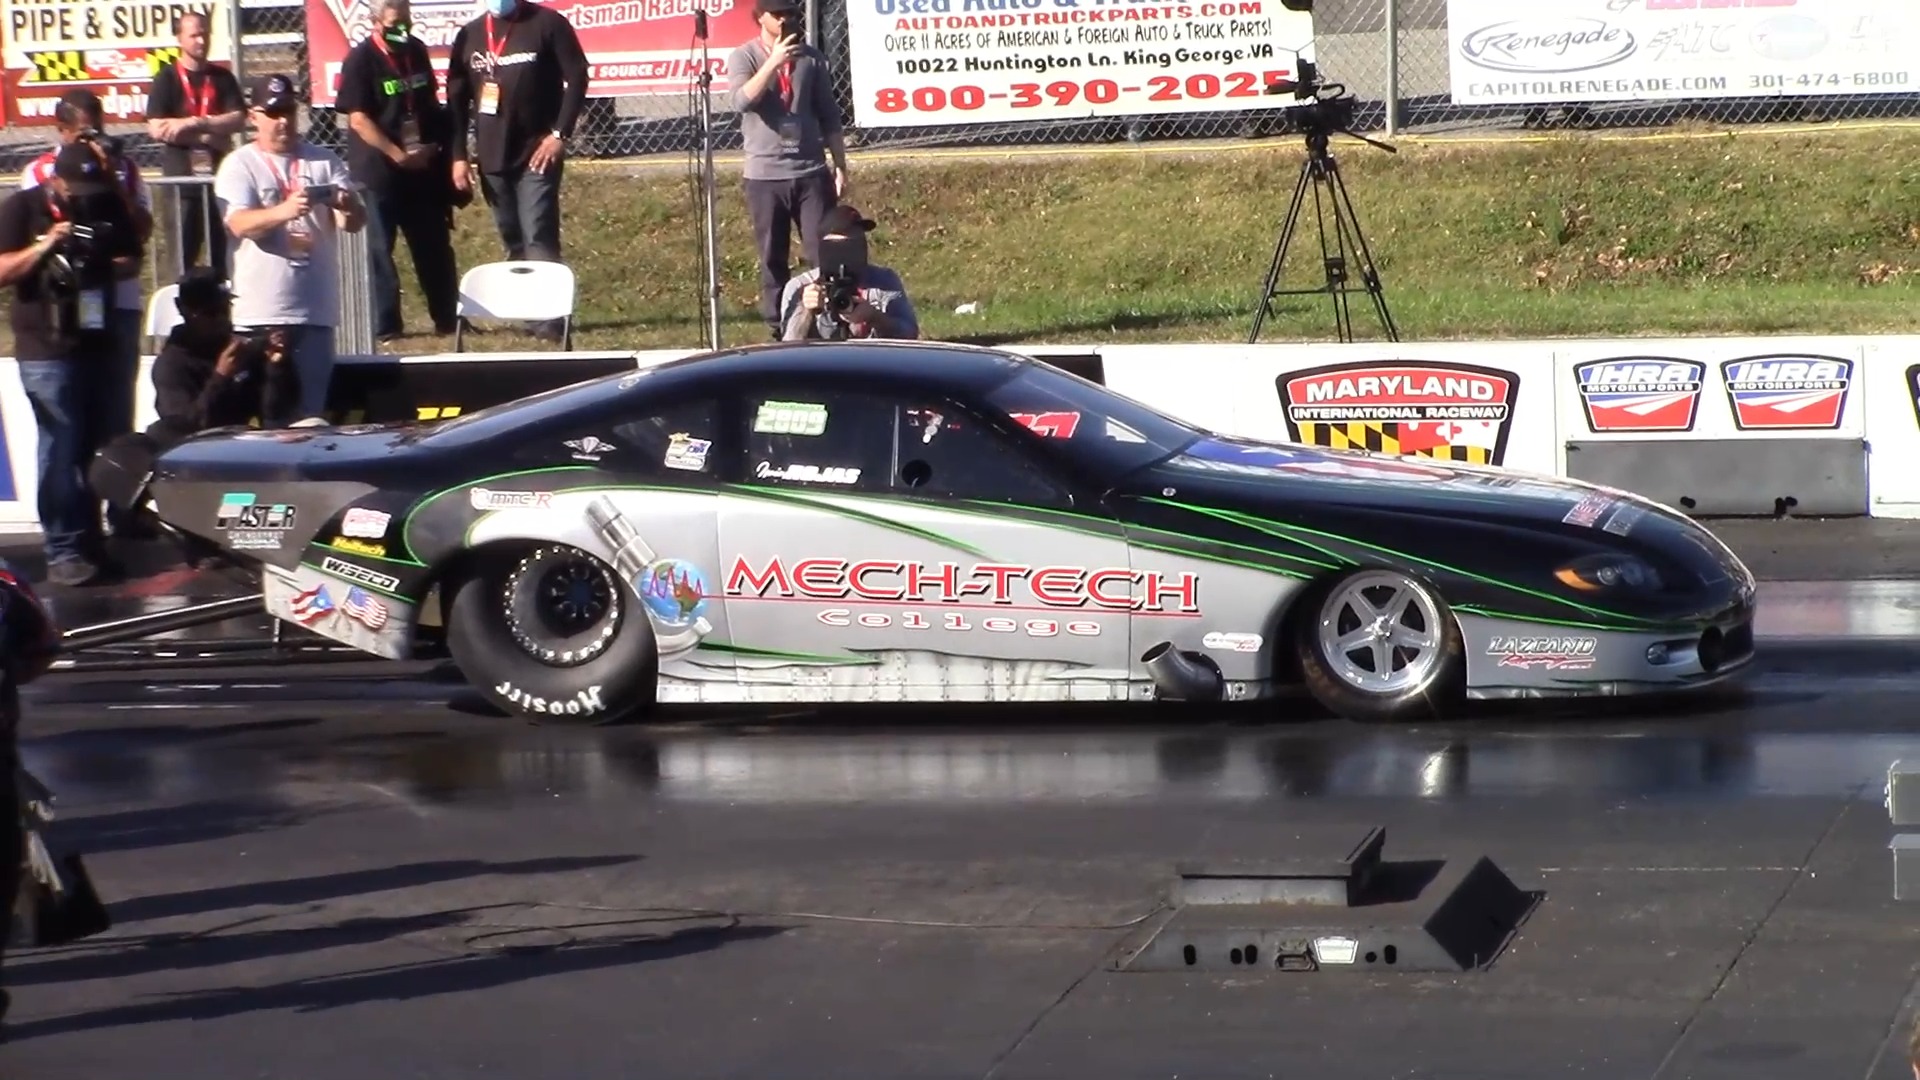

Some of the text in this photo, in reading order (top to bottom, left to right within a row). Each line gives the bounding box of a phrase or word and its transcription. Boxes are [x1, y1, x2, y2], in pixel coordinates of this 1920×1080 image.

[11, 8, 73, 41] PIPE
[85, 7, 101, 39] &
[895, 2, 1261, 31] AUTOANDTRUCKPARTS.COM
[1064, 28, 1072, 45] &
[1173, 23, 1181, 40] &
[1477, 22, 1620, 60] Renegade
[599, 63, 654, 77] SOURCE
[654, 62, 668, 76] of
[896, 58, 958, 74] 10022
[965, 53, 1081, 73] Huntington
[1088, 52, 1117, 67] Ln.
[1124, 49, 1171, 67] King
[1469, 71, 1909, 97] CAPITOLRENEGADE.COM 301-474-6800
[1591, 363, 1691, 384] IHRA
[1737, 363, 1838, 382] IHRA
[1306, 376, 1494, 403] MARYLAND
[1587, 383, 1693, 393] MOTORSPORTS
[1733, 381, 1840, 391] MOTORSPORTS
[1294, 406, 1504, 419] INTERNATIONAL RACEWAY
[725, 553, 1200, 613] MECH-TECH
[817, 608, 1101, 637] College
